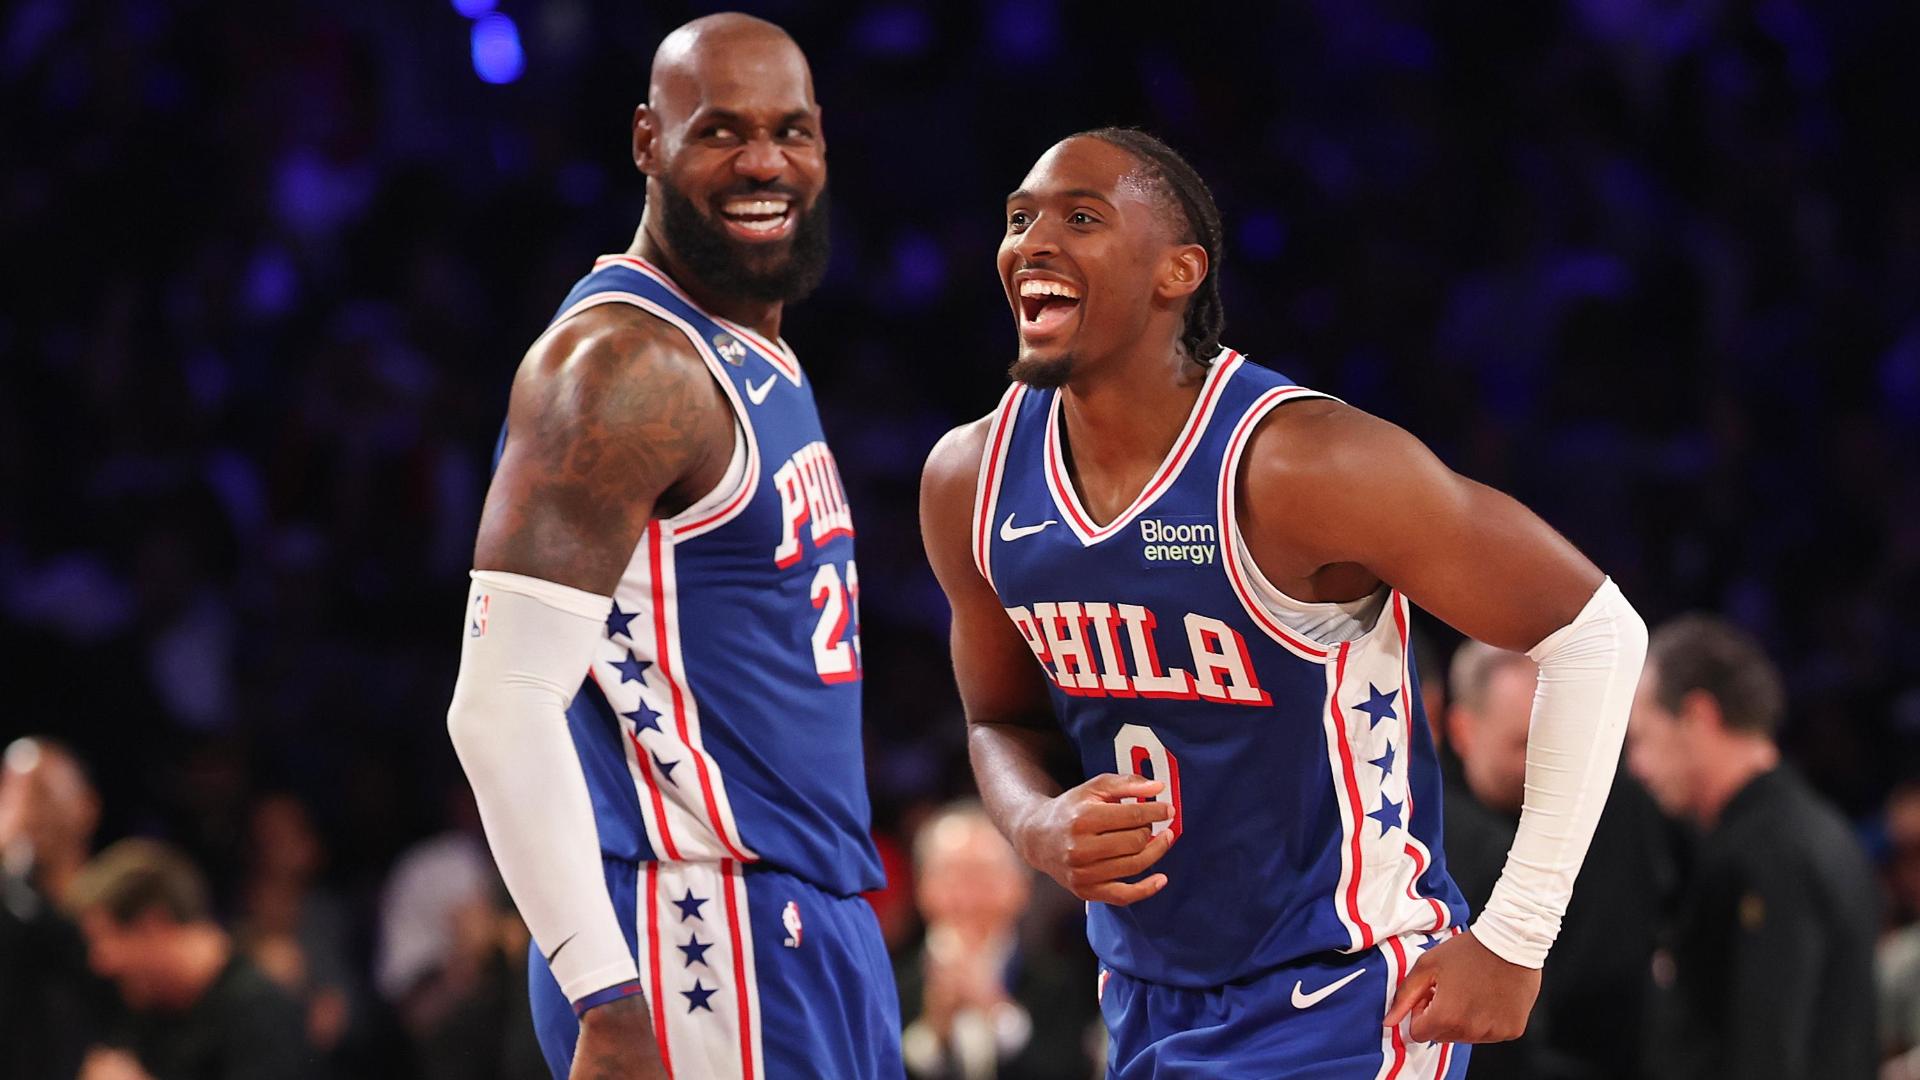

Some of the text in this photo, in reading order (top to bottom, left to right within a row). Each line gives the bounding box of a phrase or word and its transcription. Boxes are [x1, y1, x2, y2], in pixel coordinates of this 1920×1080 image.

[773, 440, 857, 569] PHIL
[1140, 519, 1215, 542] Bloom
[1144, 544, 1215, 565] energy
[1005, 602, 1274, 706] PHILA
